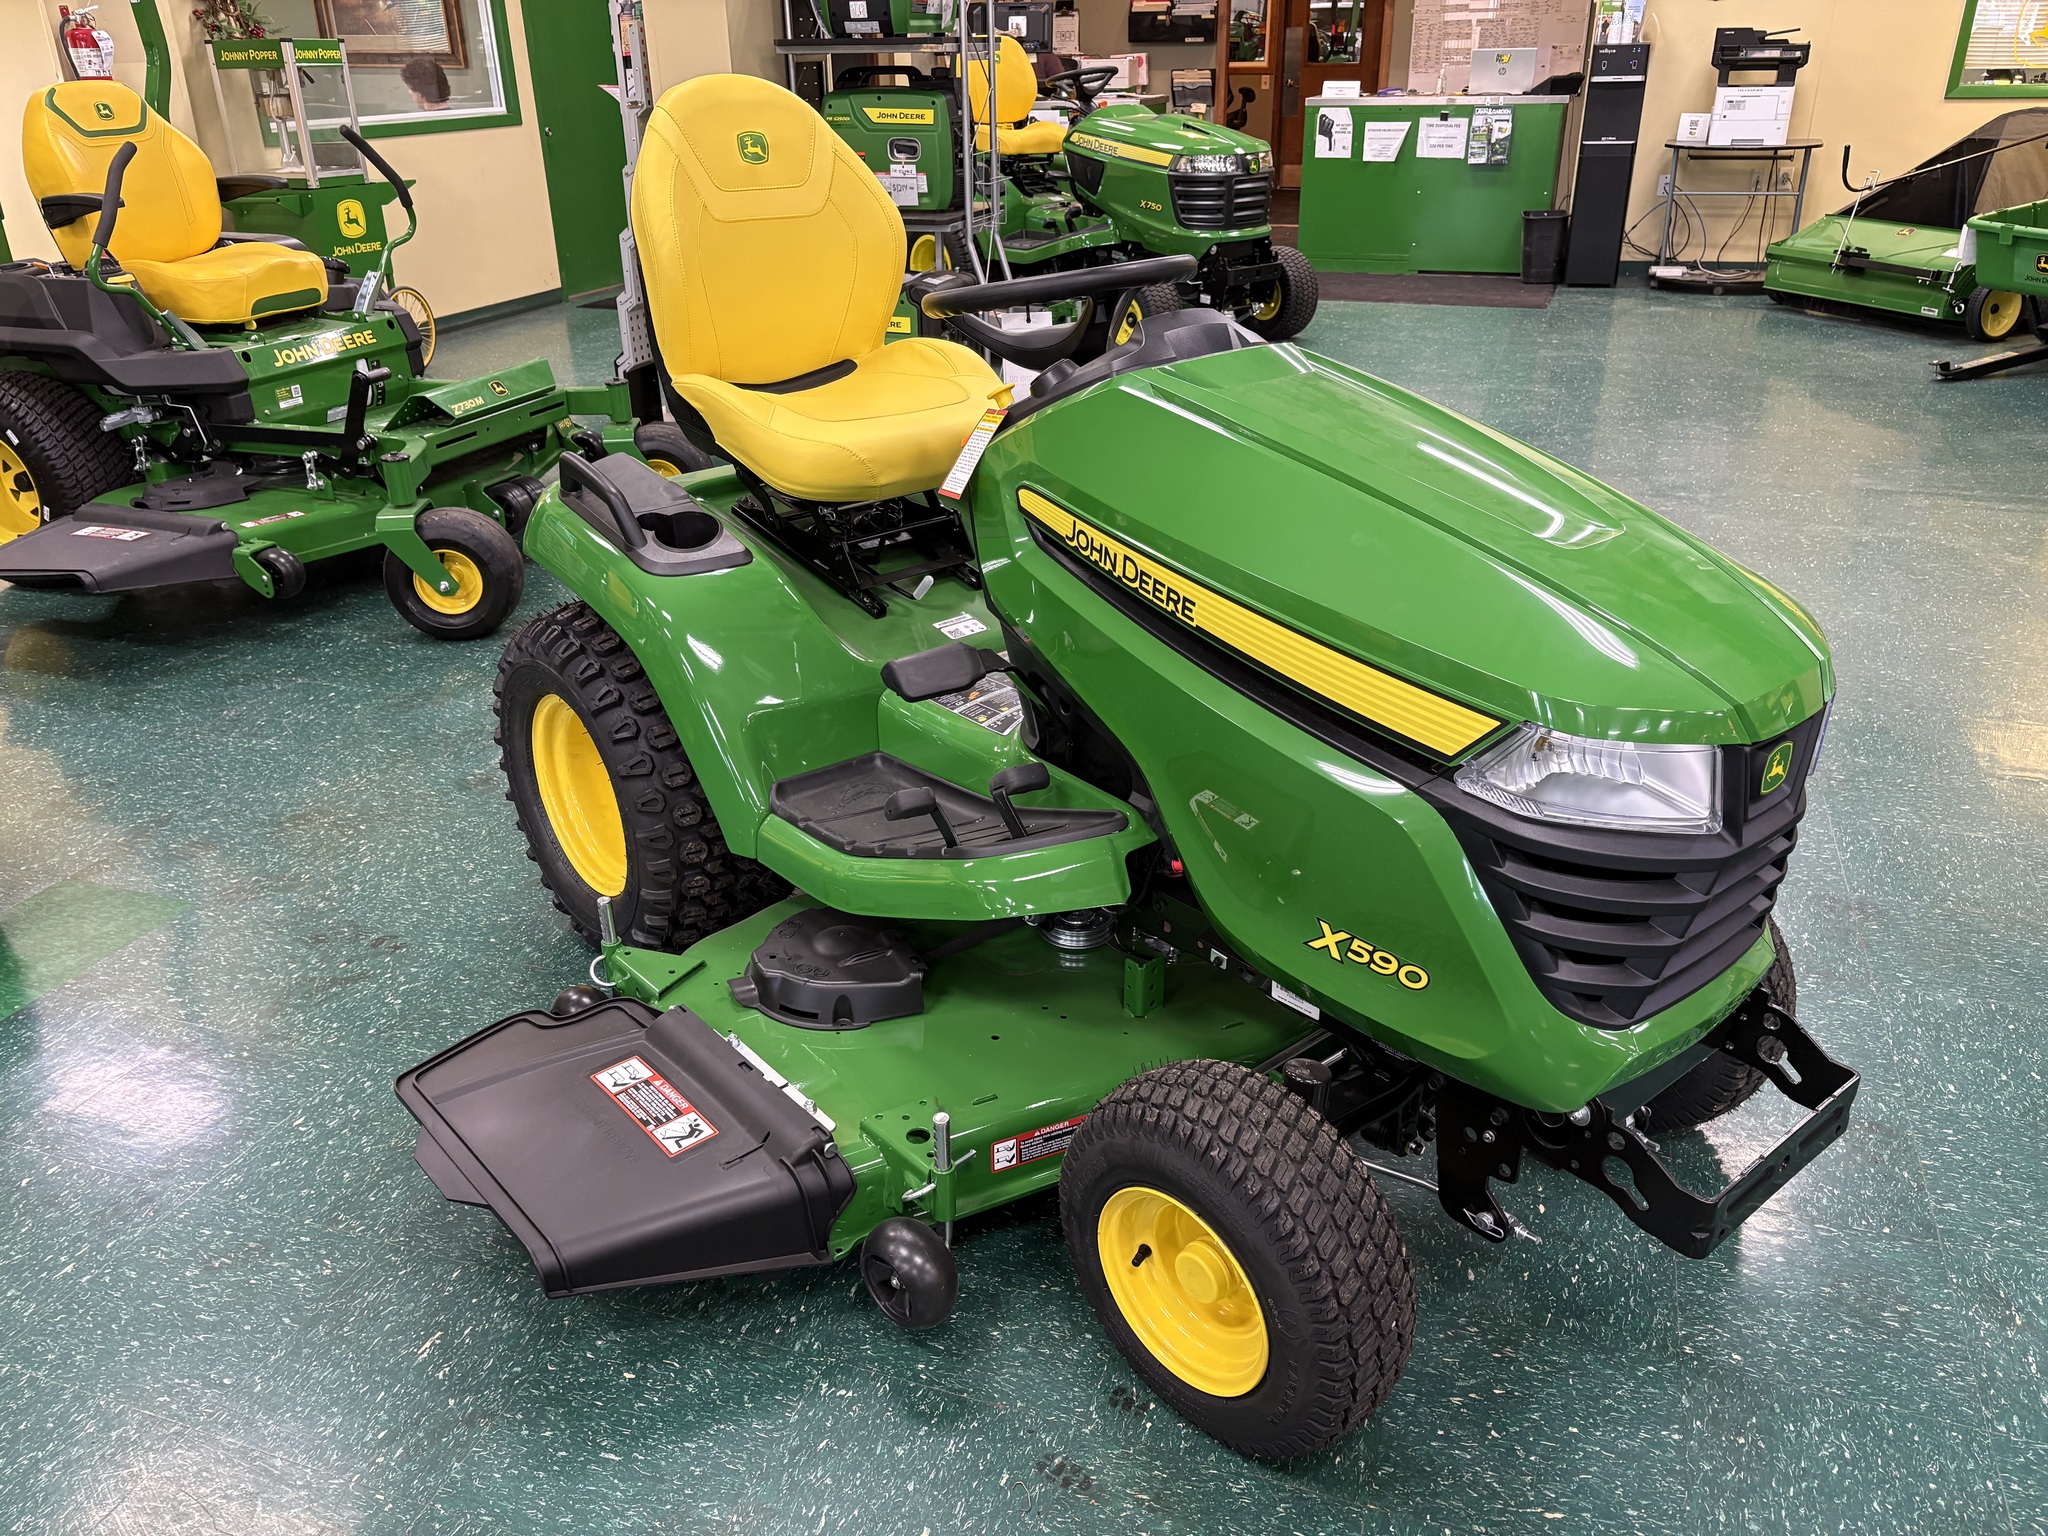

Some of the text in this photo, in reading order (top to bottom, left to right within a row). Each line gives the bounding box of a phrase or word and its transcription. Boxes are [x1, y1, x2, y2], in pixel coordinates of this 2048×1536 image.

[221, 49, 278, 61] JOHNNY POPPER
[295, 48, 341, 59] JOHNNY POPPER
[899, 112, 925, 120] DEERE
[1074, 135, 1119, 156] JOHN DEERE
[1139, 199, 1162, 212] X750
[332, 241, 382, 257] JOHN DEERE
[2025, 275, 2041, 283] JOHN
[273, 329, 378, 368] JOHN DEERE
[1065, 519, 1197, 624] JOHN DEERE
[1303, 916, 1430, 990] X590
[660, 1083, 690, 1110] DANGER
[1041, 1121, 1070, 1134] DANGER
